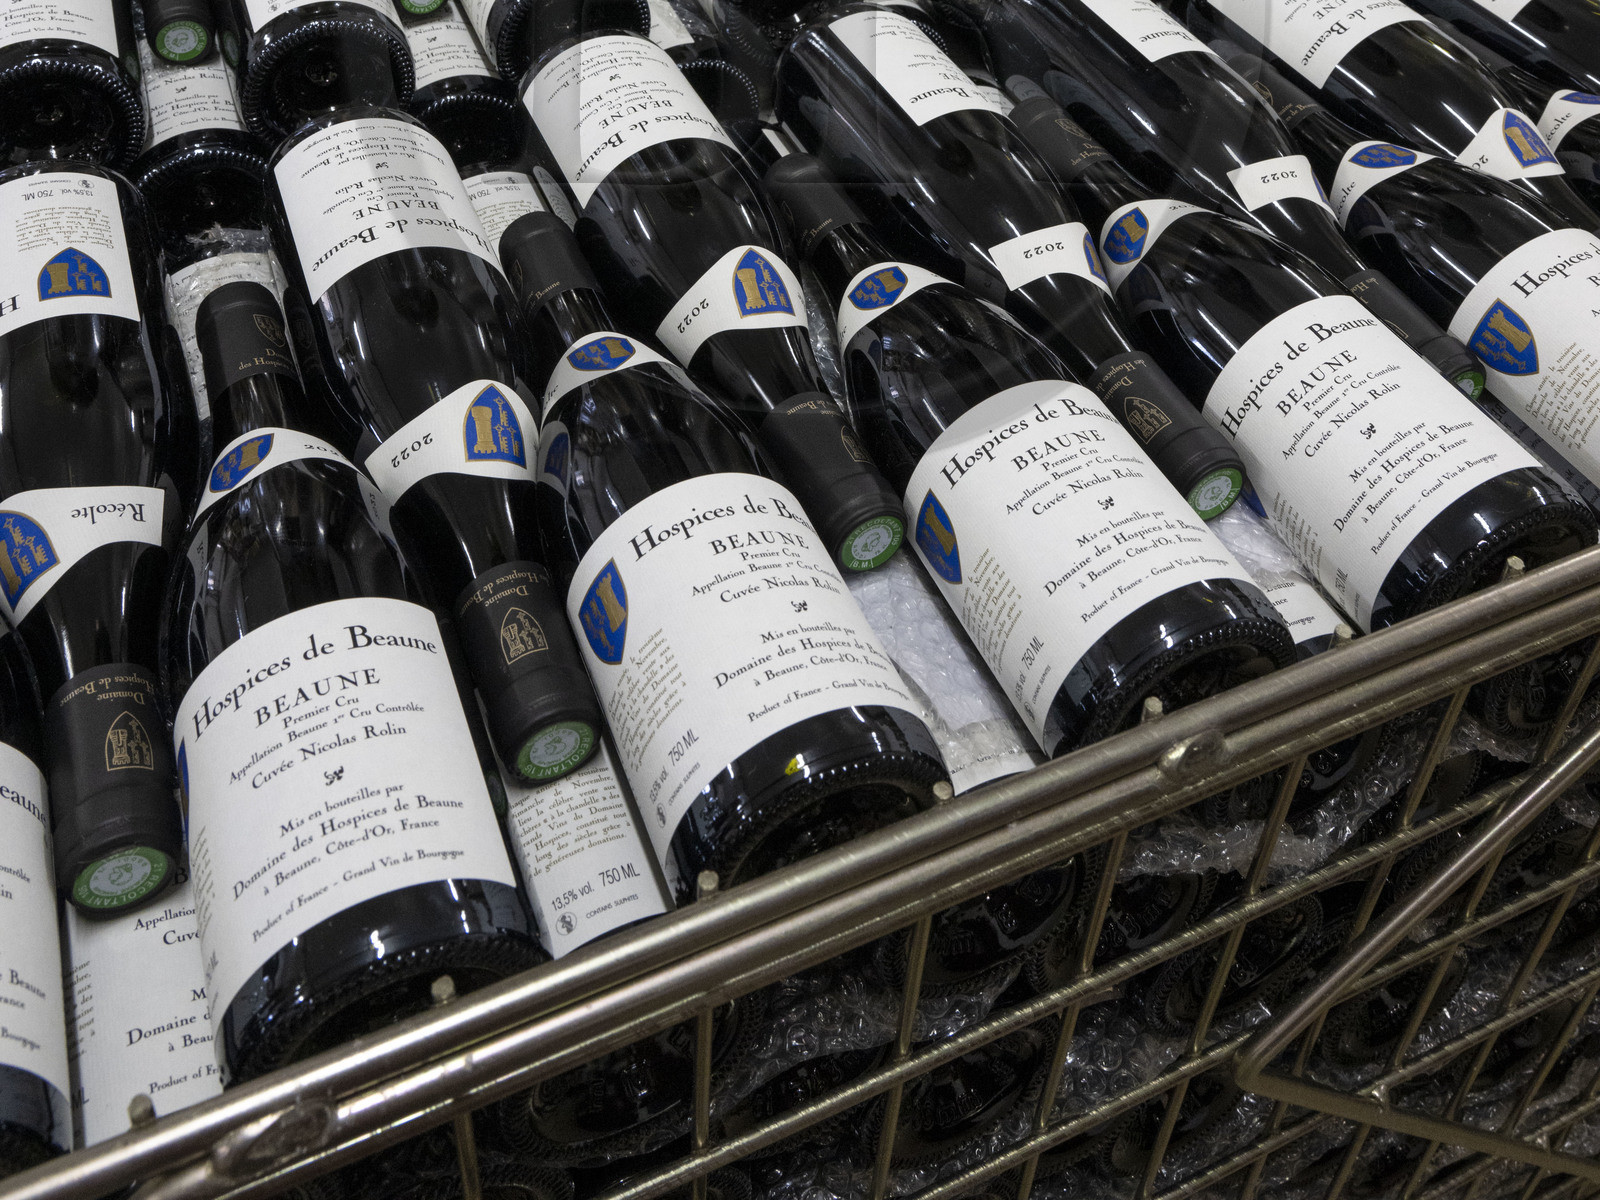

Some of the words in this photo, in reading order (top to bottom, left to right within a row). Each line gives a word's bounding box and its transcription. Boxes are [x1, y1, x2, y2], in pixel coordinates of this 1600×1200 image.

[1348, 9, 1366, 20] de
[1301, 20, 1351, 66] Beaune
[599, 100, 673, 129] BEAUNE
[909, 87, 970, 104] Beaune
[630, 120, 648, 133] de
[575, 130, 627, 181] Beaune
[1261, 170, 1298, 184] 2022
[352, 201, 439, 220] BEAUNE
[386, 218, 408, 233] de
[312, 227, 379, 272] Beaune
[1024, 241, 1064, 260] 2022
[1511, 250, 1593, 298] Hospices
[677, 298, 708, 334] 2022
[1103, 361, 1136, 382] Hospices
[1220, 361, 1284, 441] Hospices
[1288, 338, 1310, 362] de
[1305, 315, 1379, 344] Beaune
[1276, 350, 1358, 417] BEAUNE
[1303, 387, 1332, 411] Premier
[1334, 373, 1352, 387] Cru
[1282, 419, 1315, 460] Appellation
[1314, 396, 1341, 420] Beaune
[1351, 379, 1368, 393] Cru
[1368, 363, 1402, 380] Contrôlée
[1304, 430, 1332, 458] Cuvée
[1330, 400, 1367, 430] Nicolas
[1368, 382, 1400, 402] Rolin
[392, 433, 433, 468] 2022
[940, 419, 1028, 489] Hospices
[1036, 403, 1059, 423] de
[1011, 429, 1105, 472] BEAUNE
[1041, 453, 1078, 472] Premier
[1348, 464, 1368, 484] Mis
[1378, 431, 1413, 460] bouteilles
[1413, 422, 1426, 434] par
[1006, 480, 1050, 515] Appellation
[1051, 464, 1083, 482] Beaune
[1032, 492, 1068, 516] Cuvée
[1069, 472, 1112, 493] Nicolas
[1113, 468, 1143, 480] Rolin
[1334, 492, 1368, 533] Domaine
[1368, 473, 1383, 490] des
[1382, 439, 1424, 473] Hospices
[1428, 430, 1440, 441] de
[1441, 419, 1475, 431] Beaune
[1366, 486, 1397, 517] Beaune,
[1397, 454, 1442, 485] Côte-d'Or,
[1441, 437, 1468, 453] France
[71, 503, 146, 525] Récolte
[1371, 529, 1392, 556] Product
[1421, 479, 1443, 499] Grand
[1466, 453, 1498, 467] Bourgogne
[628, 503, 735, 562] Hospices
[743, 495, 766, 514] de
[708, 530, 809, 556] BEAUNE
[1075, 531, 1098, 548] Mis
[1113, 510, 1151, 529] bouteilles
[740, 550, 778, 562] Premier
[1043, 558, 1092, 597] Domaine
[1095, 543, 1112, 557] des
[1112, 523, 1163, 547] Hospices
[1087, 558, 1126, 582] Beaune,
[1126, 536, 1174, 558] Côte-d'Or,
[484, 580, 494, 592] de
[485, 585, 528, 606] Domaine
[691, 569, 745, 597] Appellation
[749, 562, 782, 573] Beaune
[720, 584, 760, 603] Cuvée
[767, 576, 809, 590] Nicolas
[813, 576, 841, 594] Rolin
[1081, 601, 1109, 622] Product
[1118, 577, 1143, 596] France
[191, 654, 291, 742] Hospices
[303, 634, 334, 661] de
[344, 625, 437, 653] Beaune
[713, 659, 771, 689] Domaine
[778, 644, 796, 657] des
[801, 638, 851, 651] Hospices
[765, 662, 808, 681] Beaune,
[253, 668, 380, 728] BEAUNE
[283, 705, 330, 729] Premier
[335, 696, 359, 706] Cru
[229, 741, 283, 784] Appellation
[288, 721, 328, 743] Beaune
[376, 703, 424, 713] Contrôlée
[252, 760, 294, 789] Cuvée
[301, 734, 356, 761] Nicolas
[364, 724, 407, 740] Rolin
[280, 818, 305, 837] Mis
[308, 810, 322, 821] en
[325, 787, 381, 812] bouteilles
[386, 783, 404, 798] par
[580, 788, 598, 797] vente
[590, 803, 623, 814] Domaine
[233, 851, 286, 900] Domaine
[292, 834, 313, 851] des
[320, 808, 387, 836] Hospices
[394, 798, 409, 811] de
[417, 795, 464, 810] Beaune
[275, 857, 320, 885] Beaune,
[325, 825, 395, 854] Côte-d'Or,
[400, 819, 439, 831] France
[252, 914, 282, 943] Product
[297, 885, 329, 907] France
[343, 867, 376, 882] Grand
[379, 856, 400, 868] Vin
[417, 847, 464, 860] Bourgogne
[552, 890, 578, 910] 13,5%
[579, 883, 594, 897] vol.
[599, 870, 620, 887] 750
[624, 863, 640, 878] ML
[586, 902, 612, 918] CONTAINS
[614, 894, 638, 908] SULPHITES
[126, 1015, 197, 1047] Domaine
[148, 1074, 188, 1094] Product
